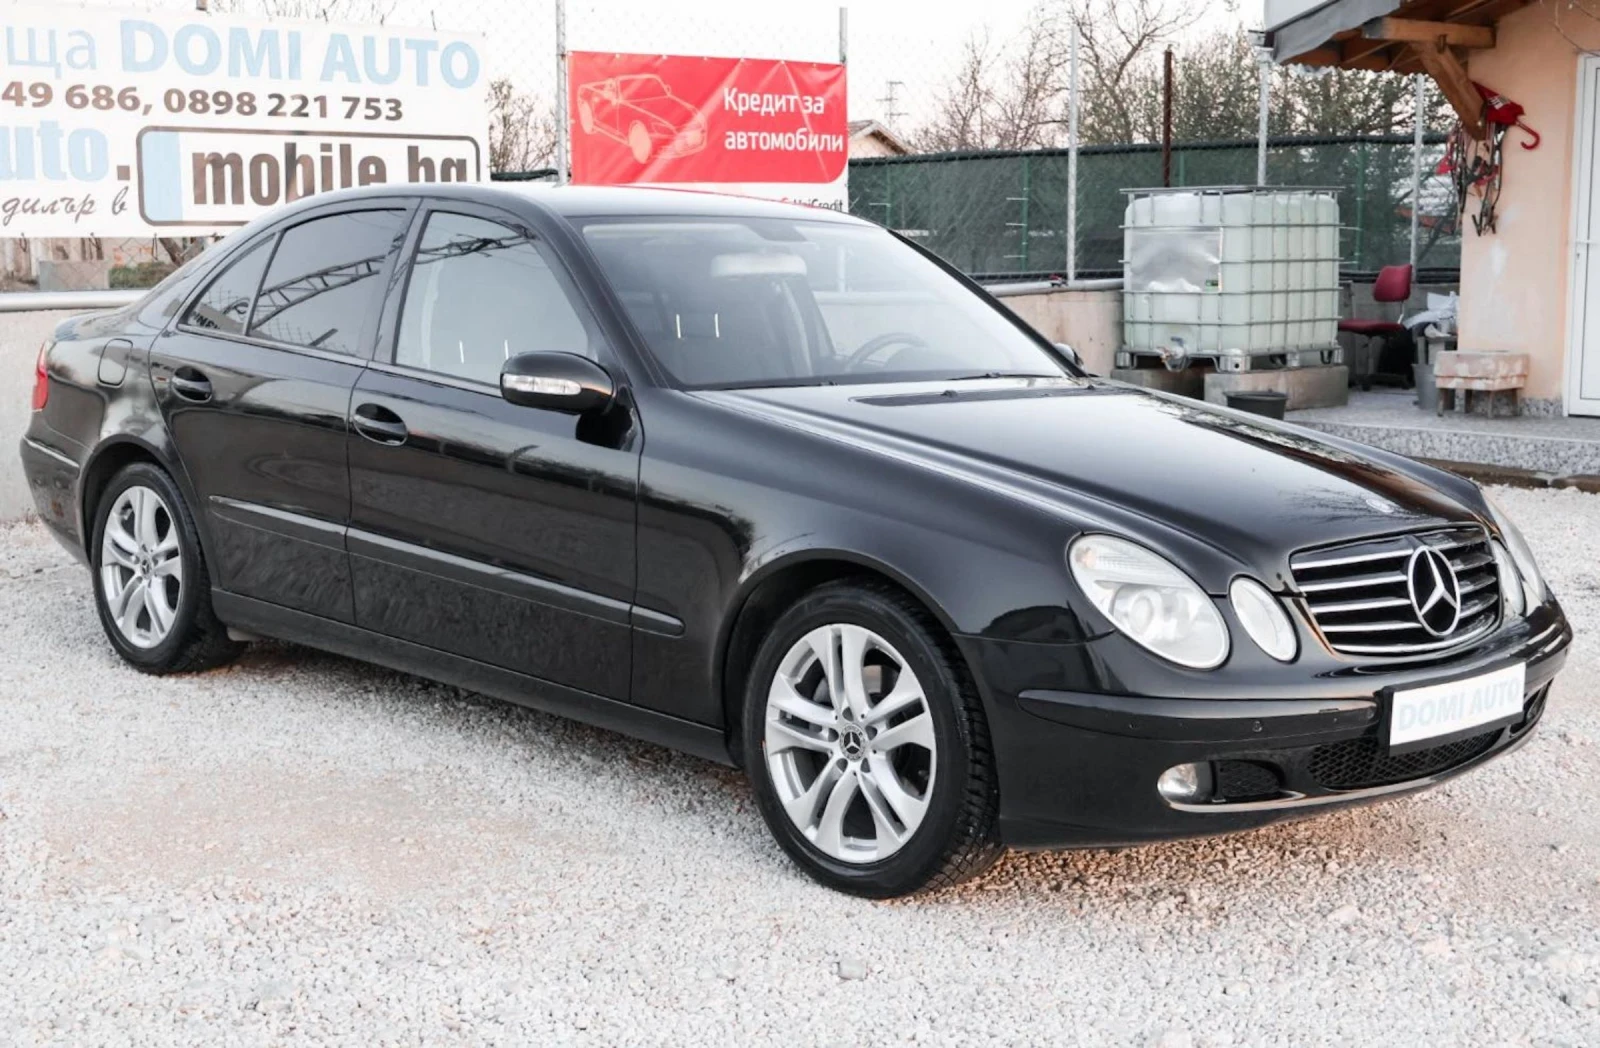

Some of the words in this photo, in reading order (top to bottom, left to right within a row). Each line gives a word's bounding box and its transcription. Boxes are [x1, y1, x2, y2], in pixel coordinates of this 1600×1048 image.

[120, 19, 301, 81] DOMI
[320, 33, 480, 89] AUTO
[1, 81, 53, 108] 49
[65, 84, 152, 116] 686,
[163, 88, 257, 116] 0898
[267, 93, 327, 118] 221
[342, 96, 403, 121] 753
[723, 87, 796, 117] Кредит
[803, 97, 825, 114] за
[724, 128, 843, 151] автомобили
[1399, 691, 1464, 731] DOMI
[1470, 677, 1520, 715] AUTO
